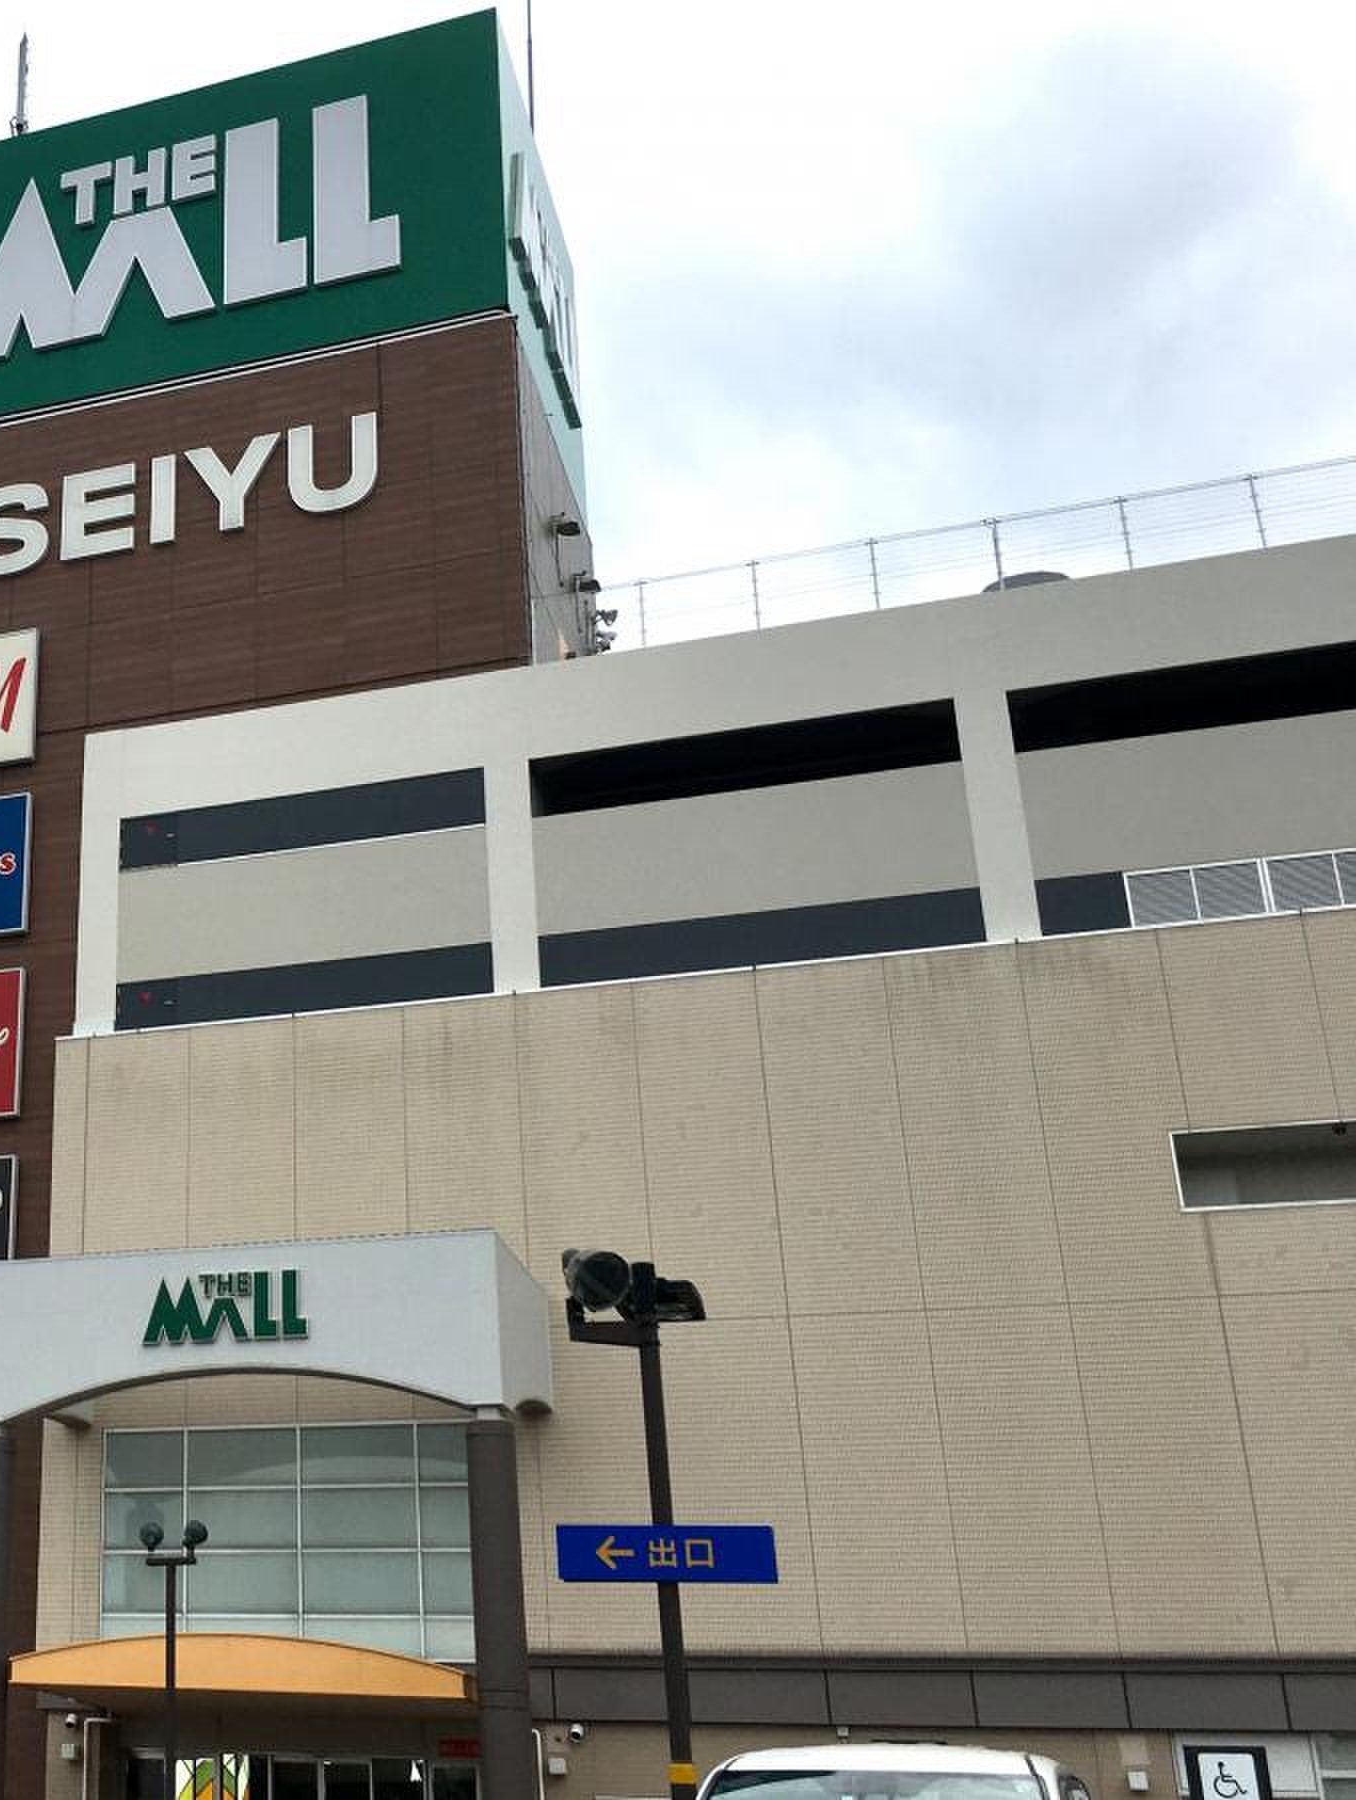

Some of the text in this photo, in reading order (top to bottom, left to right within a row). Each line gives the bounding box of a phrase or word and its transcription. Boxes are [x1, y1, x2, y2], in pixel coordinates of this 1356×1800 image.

[60, 133, 217, 227] THE
[142, 1269, 309, 1345] MALL
[199, 1272, 252, 1298] THE
[648, 1537, 715, 1569] 出口
